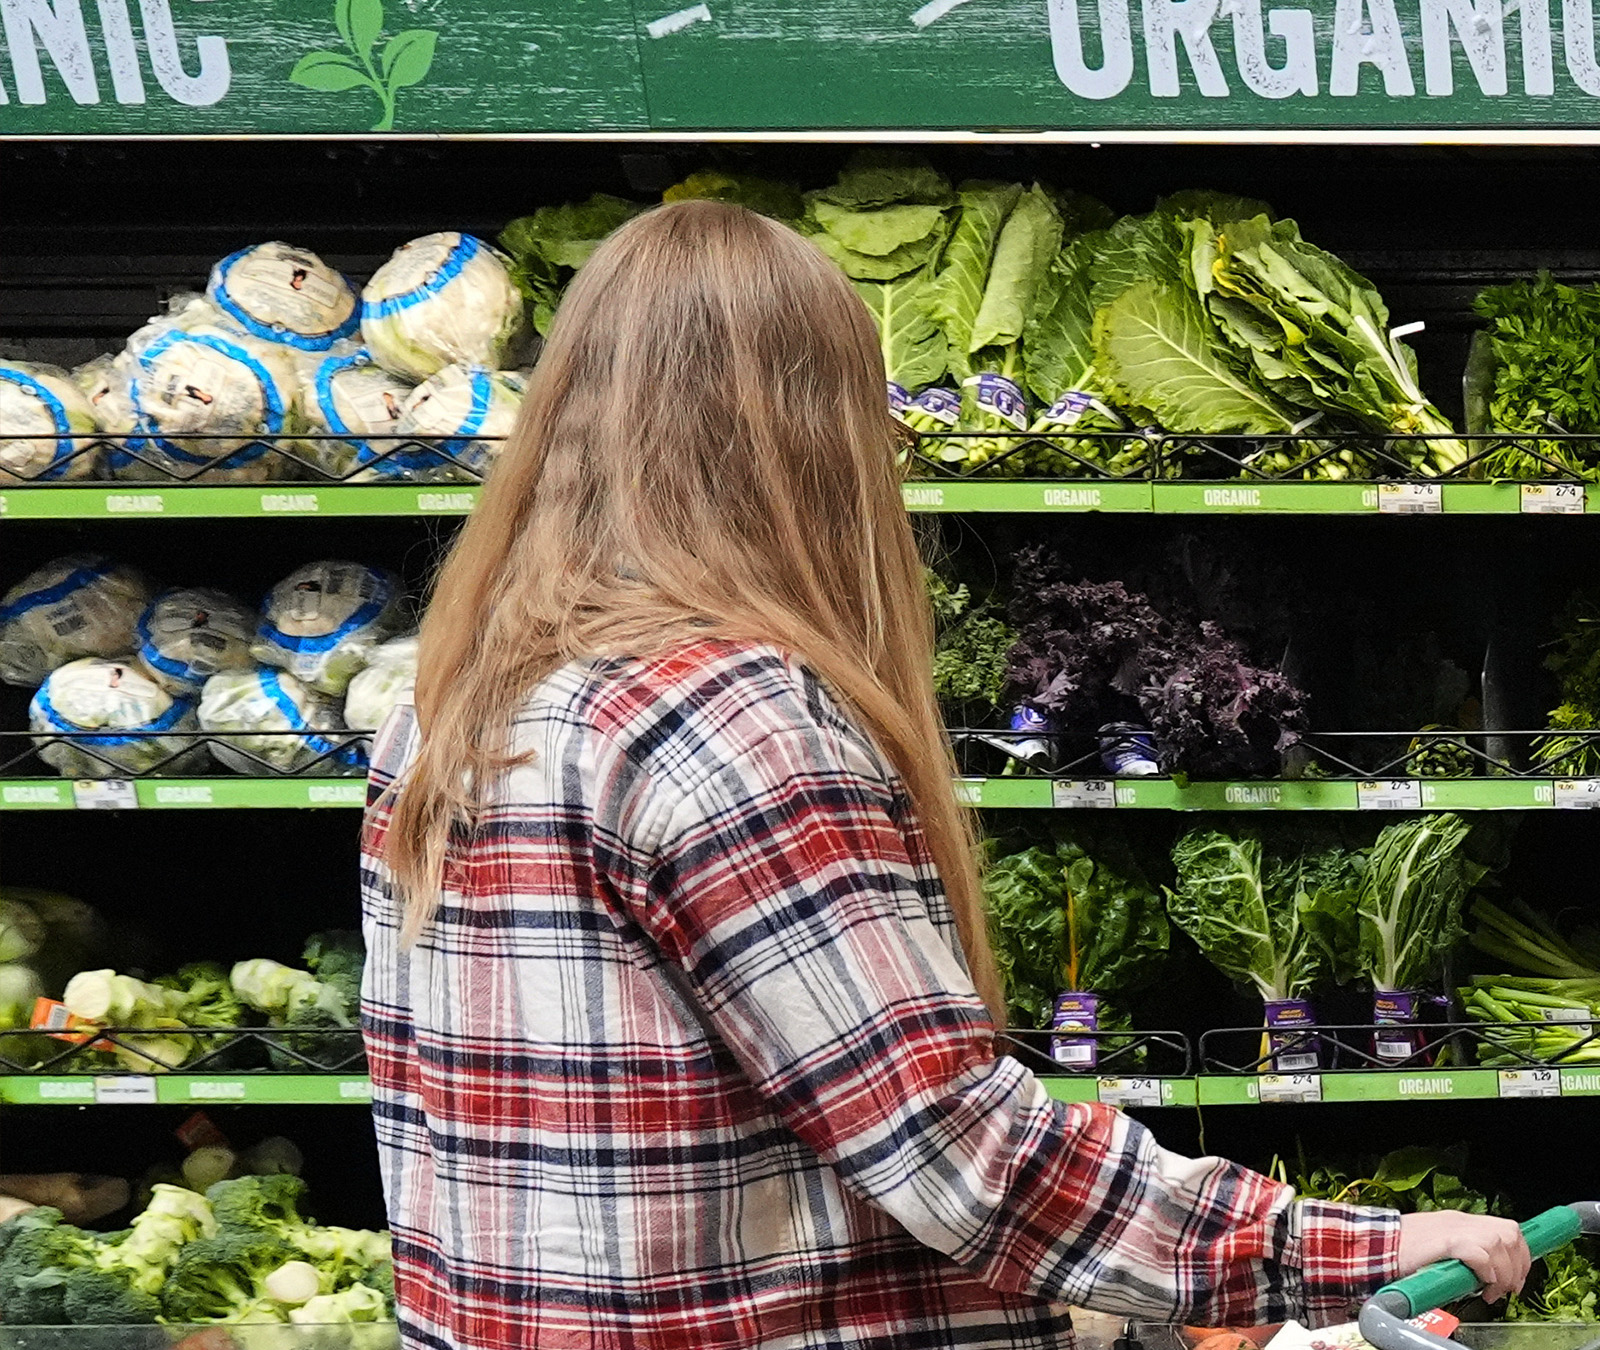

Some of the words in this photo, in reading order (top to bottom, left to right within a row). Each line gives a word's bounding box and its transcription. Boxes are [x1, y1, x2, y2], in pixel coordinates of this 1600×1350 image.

[1044, 489, 1100, 505] ORGANIC
[1204, 489, 1260, 506] ORGANIC
[1225, 787, 1281, 803] ORGANIC
[1398, 1078, 1453, 1094] ORGANIC
